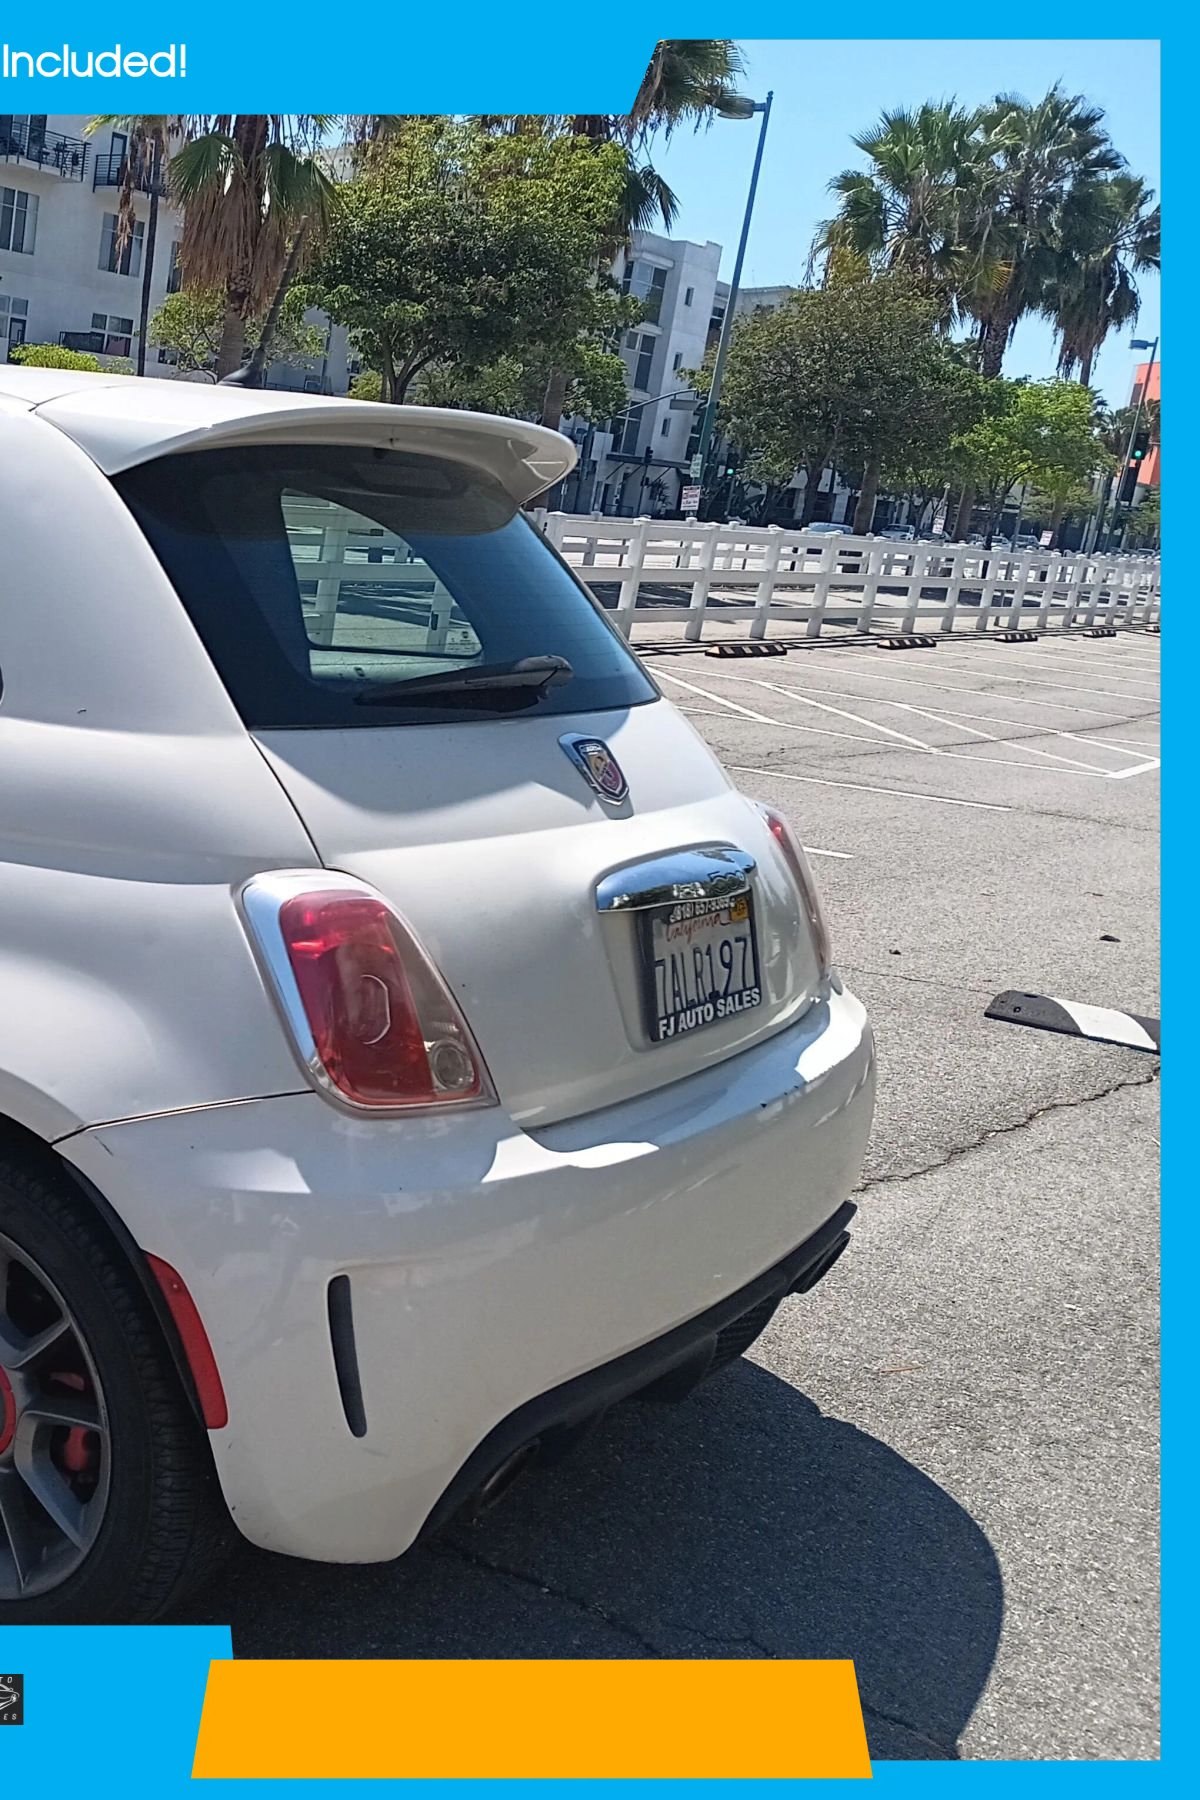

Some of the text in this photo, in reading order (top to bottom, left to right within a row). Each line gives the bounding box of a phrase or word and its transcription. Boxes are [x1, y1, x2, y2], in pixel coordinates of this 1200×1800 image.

[654, 936, 748, 1015] 7ALR197
[659, 988, 760, 1040] FJ AUTO SALES
